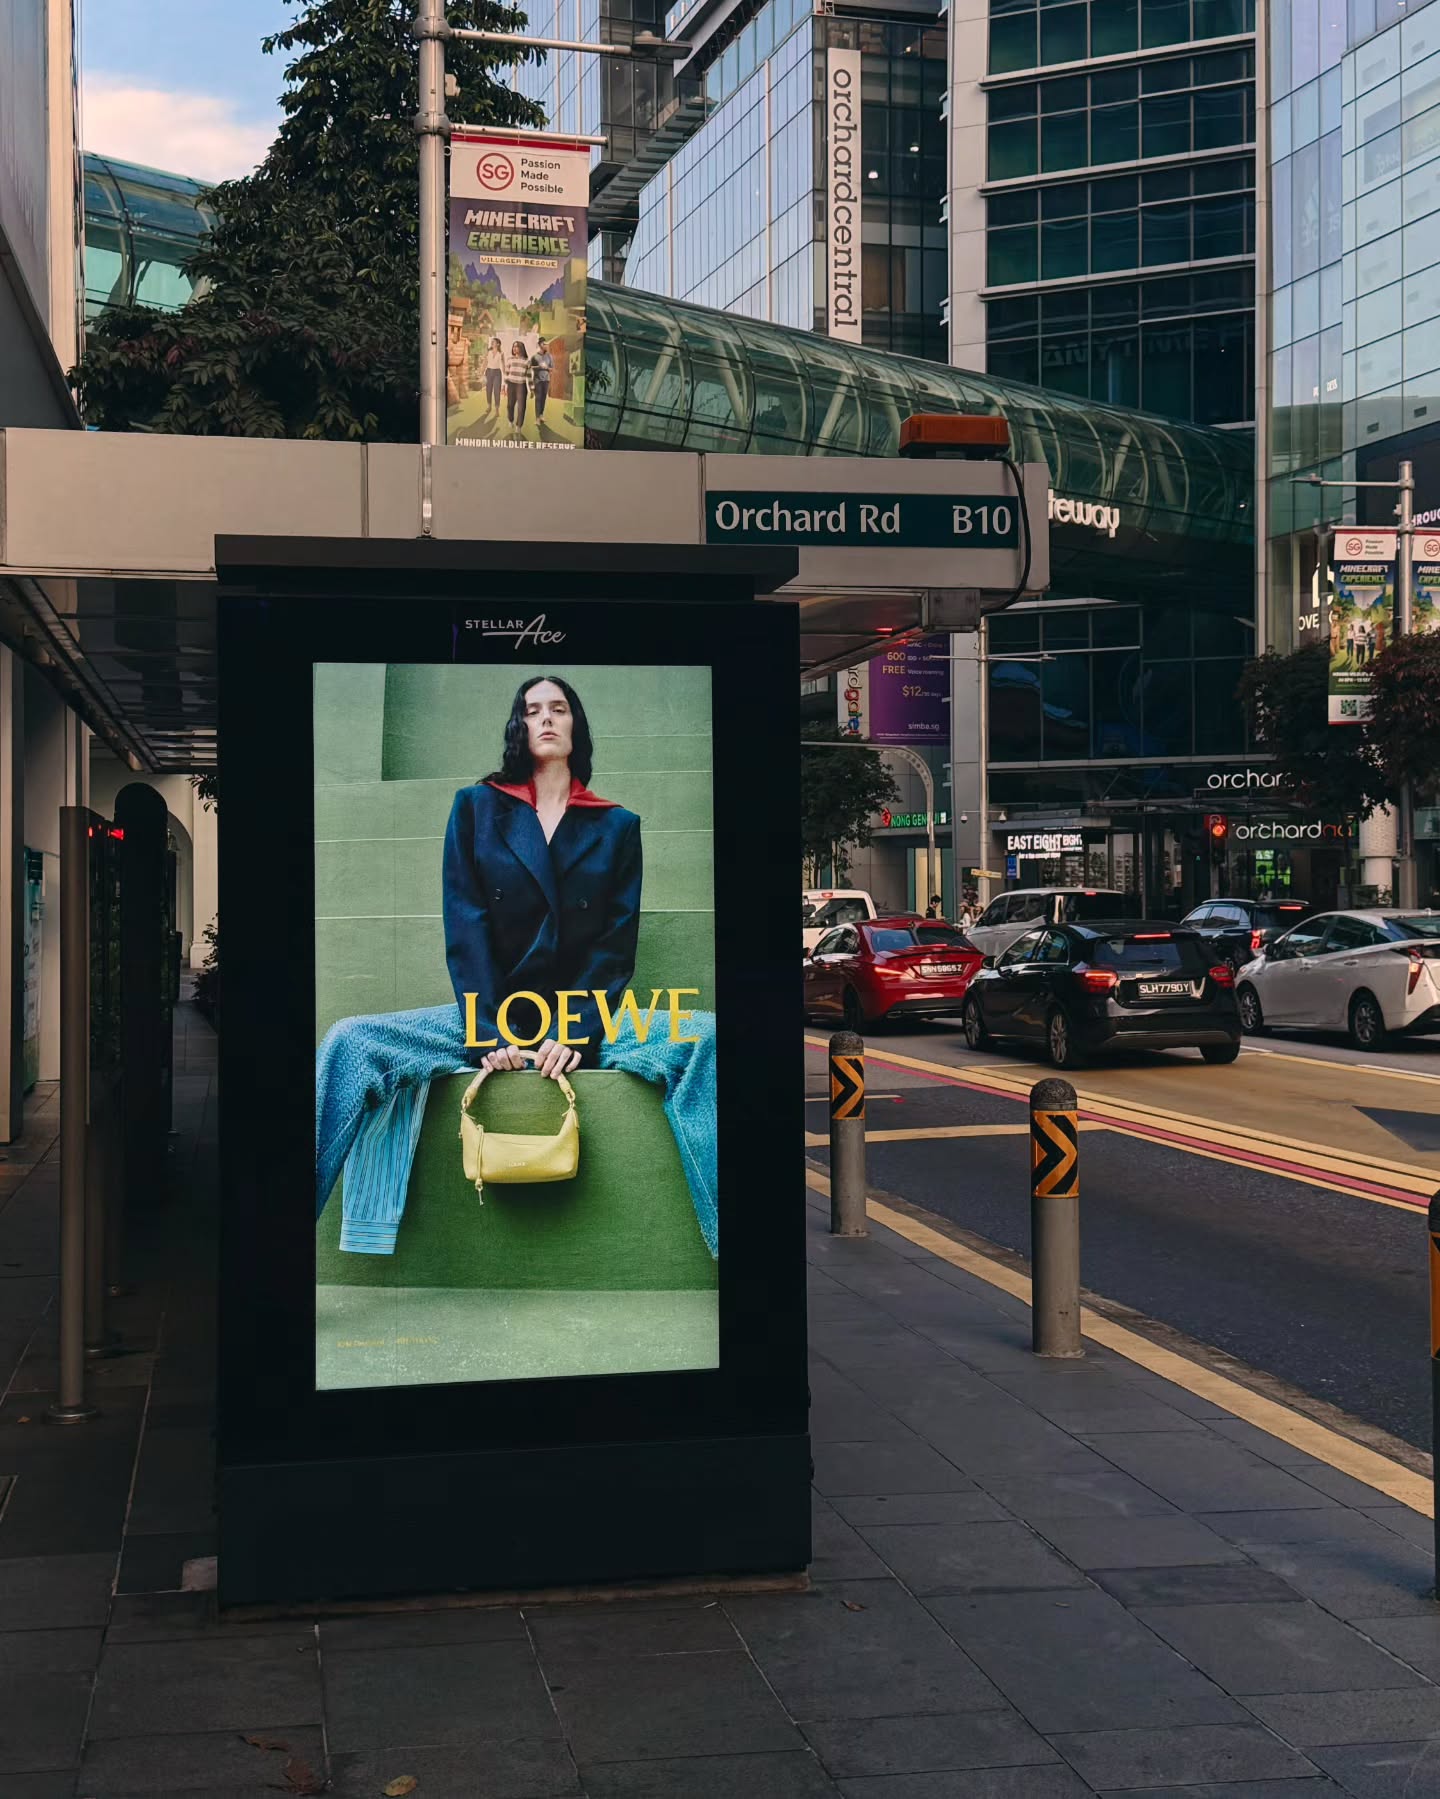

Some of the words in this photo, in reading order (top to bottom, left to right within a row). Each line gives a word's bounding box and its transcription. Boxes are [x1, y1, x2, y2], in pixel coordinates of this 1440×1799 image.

[482, 163, 510, 180] SG
[521, 158, 561, 170] Passion
[521, 170, 549, 181] Made
[520, 182, 564, 194] Possible
[833, 68, 857, 328] orchardcentral
[464, 209, 575, 233] MINECRAFT
[467, 231, 571, 257] EXPERIENCE
[455, 437, 491, 448] MANDAI
[492, 439, 534, 450] WILDLIFE
[715, 499, 846, 534] Orchard
[859, 502, 901, 535] Rd
[953, 504, 1012, 535] B10
[465, 619, 524, 629] STELLAR
[514, 613, 567, 650] Ace
[882, 665, 906, 674] FREE
[891, 814, 911, 827] NONG
[912, 812, 928, 827] GEN
[1007, 835, 1033, 850] EAST
[1034, 833, 1062, 850] EIGHT
[1139, 982, 1190, 995] SLH7790Y
[462, 987, 702, 1049] LOEWE
